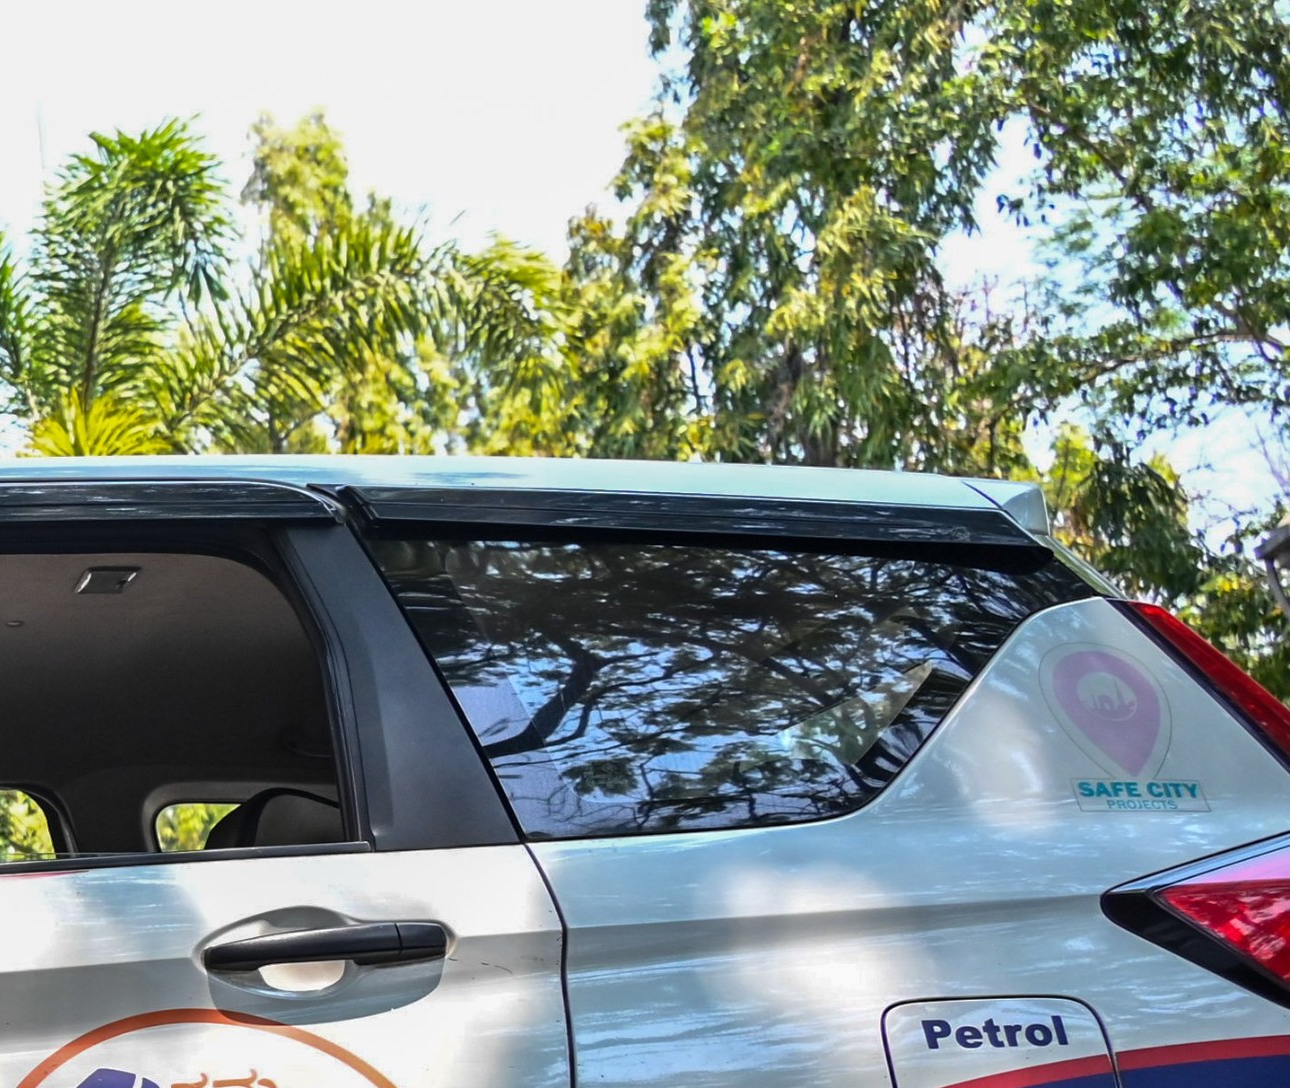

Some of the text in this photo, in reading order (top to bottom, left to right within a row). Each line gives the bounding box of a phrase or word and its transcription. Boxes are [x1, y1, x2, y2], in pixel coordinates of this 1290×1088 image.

[1077, 781, 1198, 798] SAFE CITY
[1107, 800, 1179, 810] PROJECTS
[921, 1016, 1069, 1049] Petrol
